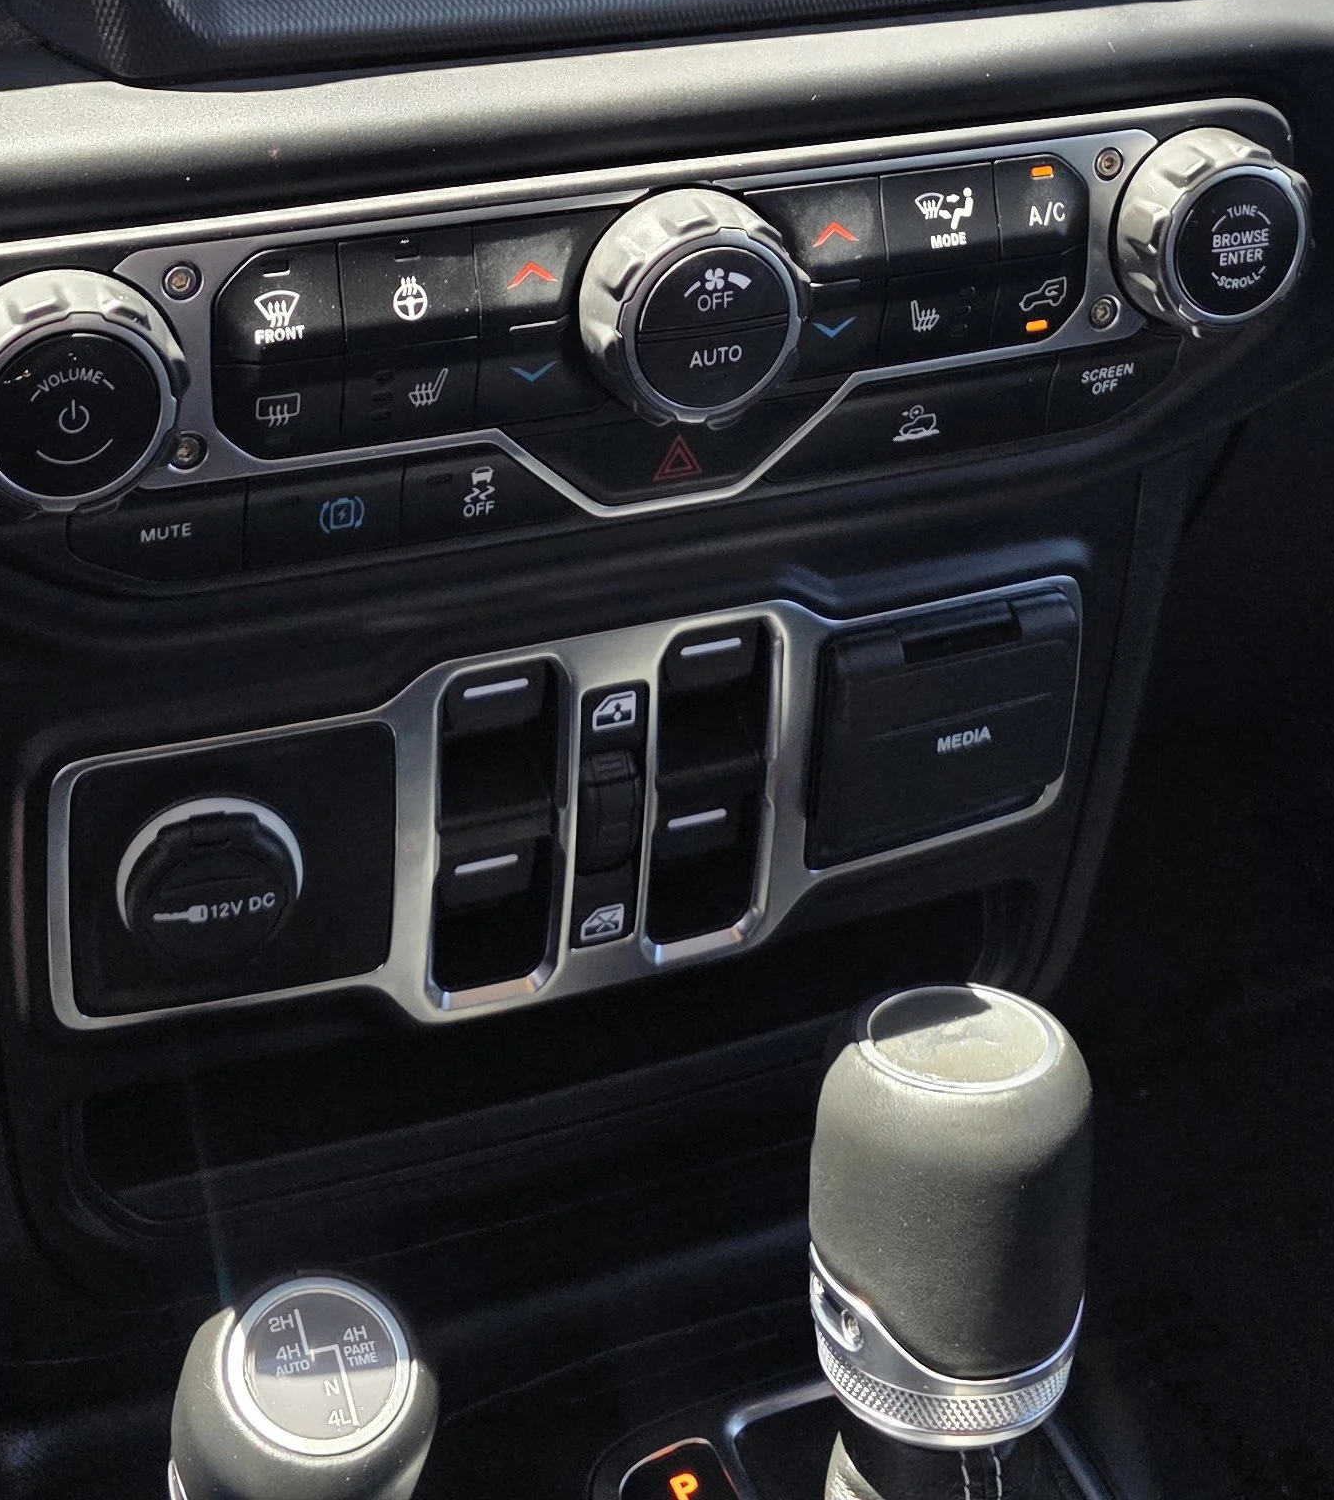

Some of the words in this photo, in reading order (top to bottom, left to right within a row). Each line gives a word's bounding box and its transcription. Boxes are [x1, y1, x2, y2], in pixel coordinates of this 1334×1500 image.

[1028, 201, 1066, 226] A/C
[1227, 204, 1258, 218] TUNE
[930, 231, 967, 249] MODE
[1212, 228, 1269, 248] BROWSE
[1219, 248, 1263, 267] ENTER
[1217, 272, 1261, 289] SCROLL
[697, 290, 734, 312] OFF
[254, 324, 305, 344] FRONT
[689, 344, 743, 369] AUTO
[37, 367, 104, 392] VOLUME
[1081, 362, 1134, 384] SCREEN
[1091, 378, 1119, 395] OFF
[463, 500, 495, 517] OFF
[140, 521, 192, 543] MUTE
[936, 725, 991, 753] MEDIA
[210, 899, 244, 919] 12V
[248, 891, 276, 912] DC
[268, 1313, 294, 1333] 2H
[342, 1325, 368, 1342] 4H
[275, 1343, 302, 1361] 4H
[343, 1341, 376, 1358] PART
[275, 1359, 311, 1377] AUTO
[347, 1352, 379, 1368] TIME
[323, 1377, 341, 1397] N
[327, 1408, 353, 1428] 4L
[669, 1472, 699, 1500] P
